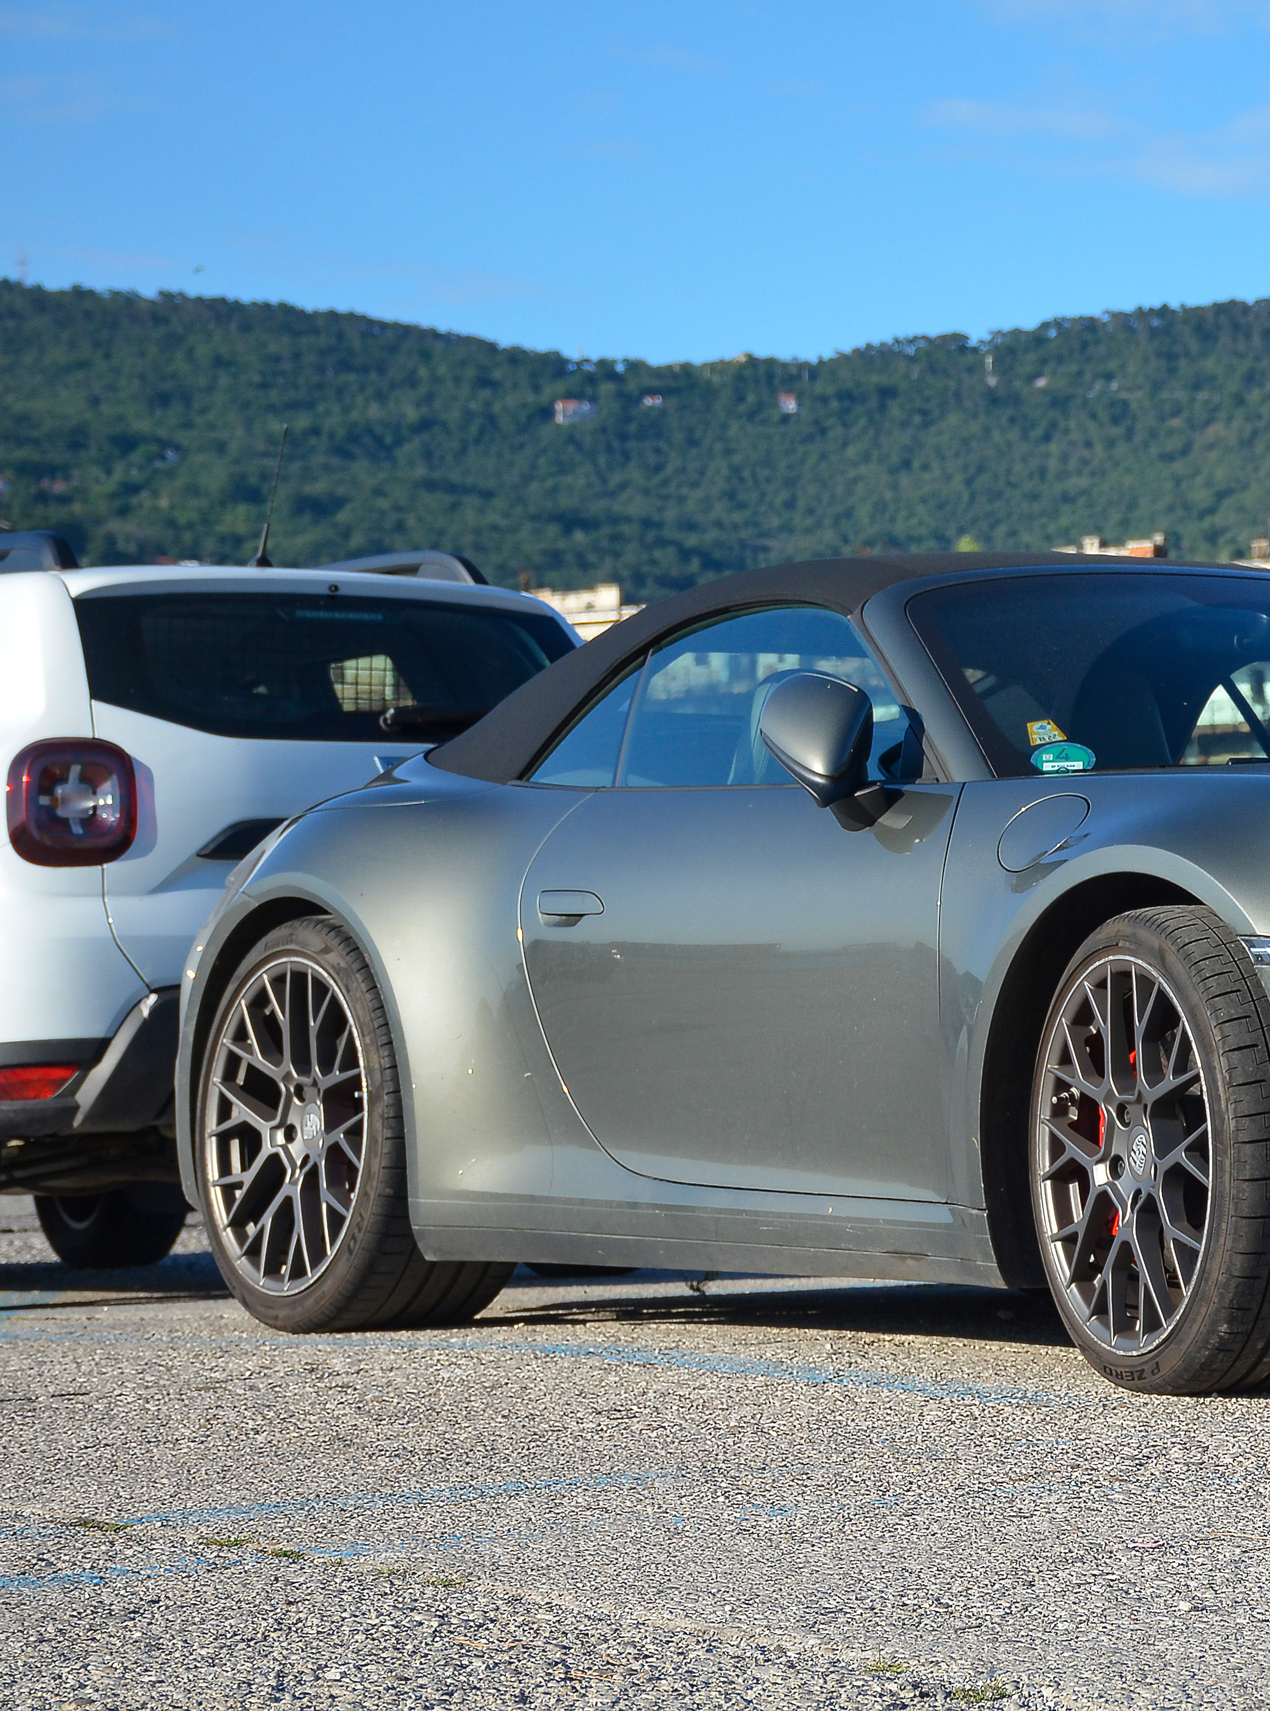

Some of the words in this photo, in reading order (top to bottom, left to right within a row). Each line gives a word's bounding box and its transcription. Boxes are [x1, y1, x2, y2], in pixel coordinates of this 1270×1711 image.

[1056, 746, 1070, 761] 4
[1103, 1364, 1147, 1381] ZERO
[1150, 1361, 1161, 1376] P
